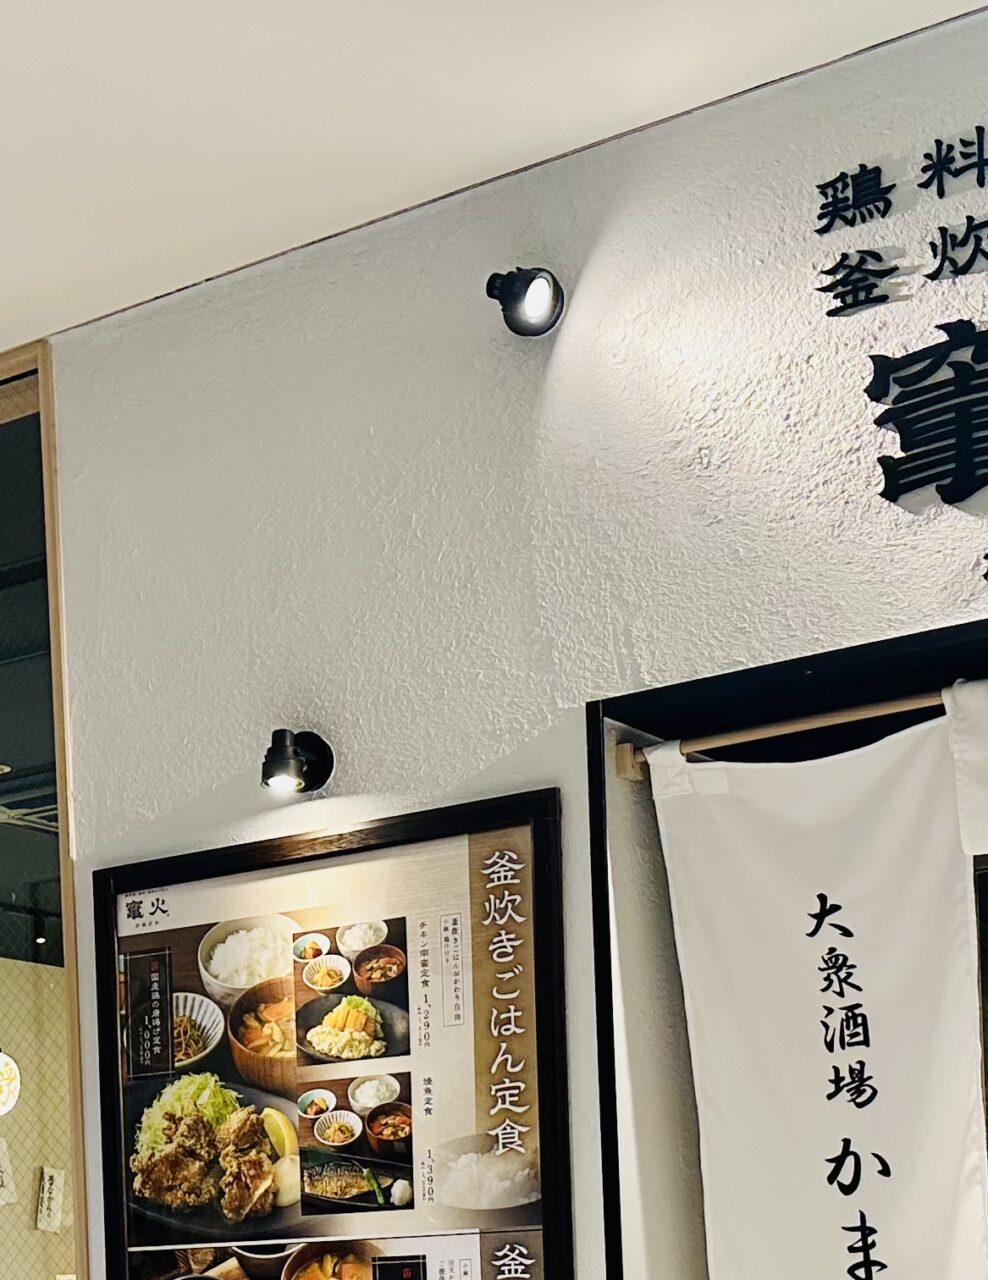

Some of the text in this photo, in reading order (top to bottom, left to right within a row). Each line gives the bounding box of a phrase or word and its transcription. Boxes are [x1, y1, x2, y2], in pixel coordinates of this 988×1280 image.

[480, 850, 531, 1156] 釜炊きごはん定食
[805, 892, 879, 1109] 大衆酒場
